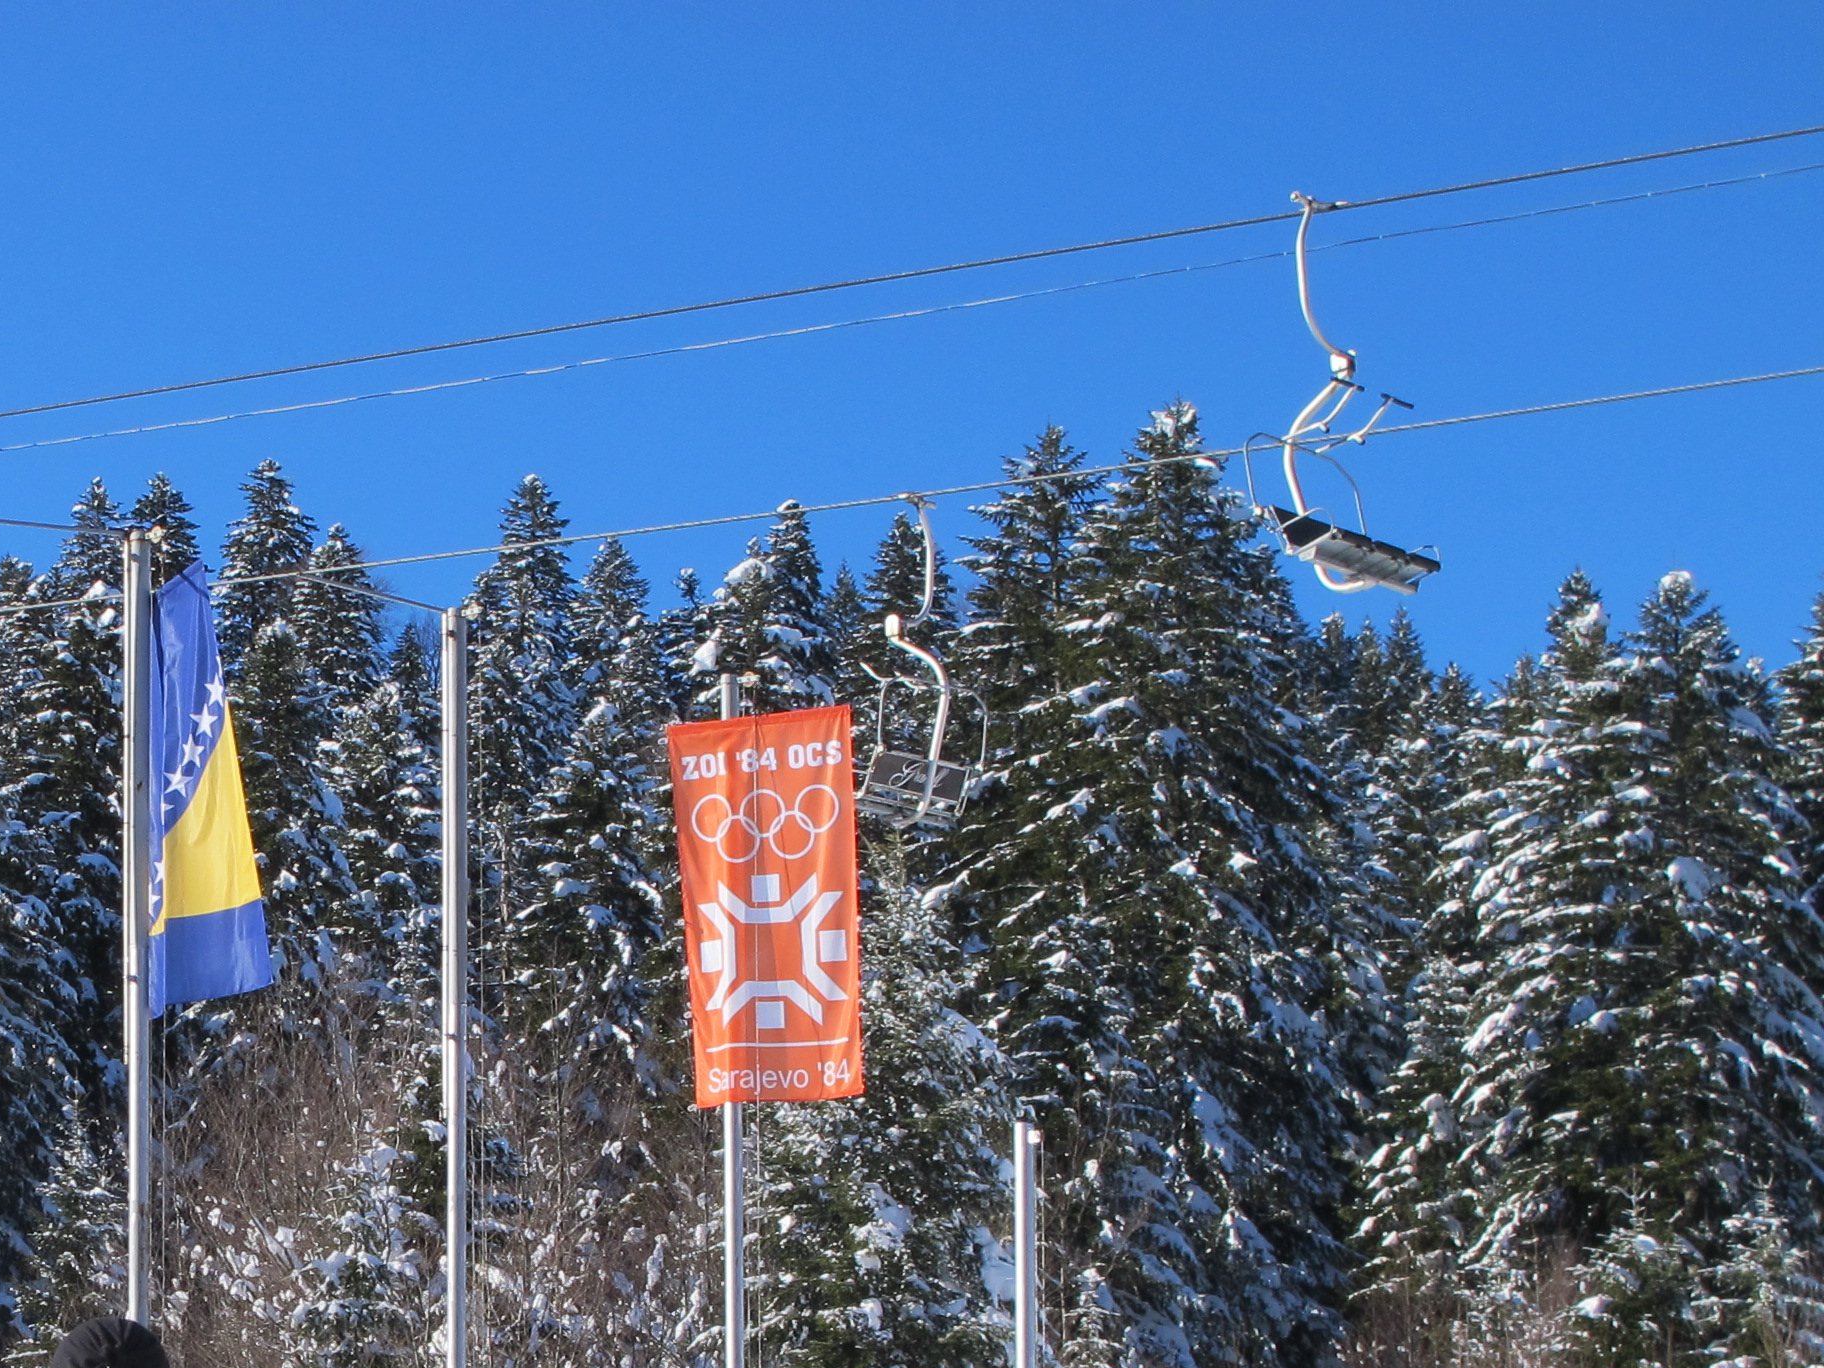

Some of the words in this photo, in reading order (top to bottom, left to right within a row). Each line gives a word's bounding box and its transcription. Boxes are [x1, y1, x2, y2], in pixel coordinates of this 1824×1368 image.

[681, 752, 727, 781] ZOI
[736, 747, 777, 774] '84
[788, 740, 843, 770] OCS
[708, 1065, 809, 1095] Sarajevo
[817, 1058, 850, 1087] '84
